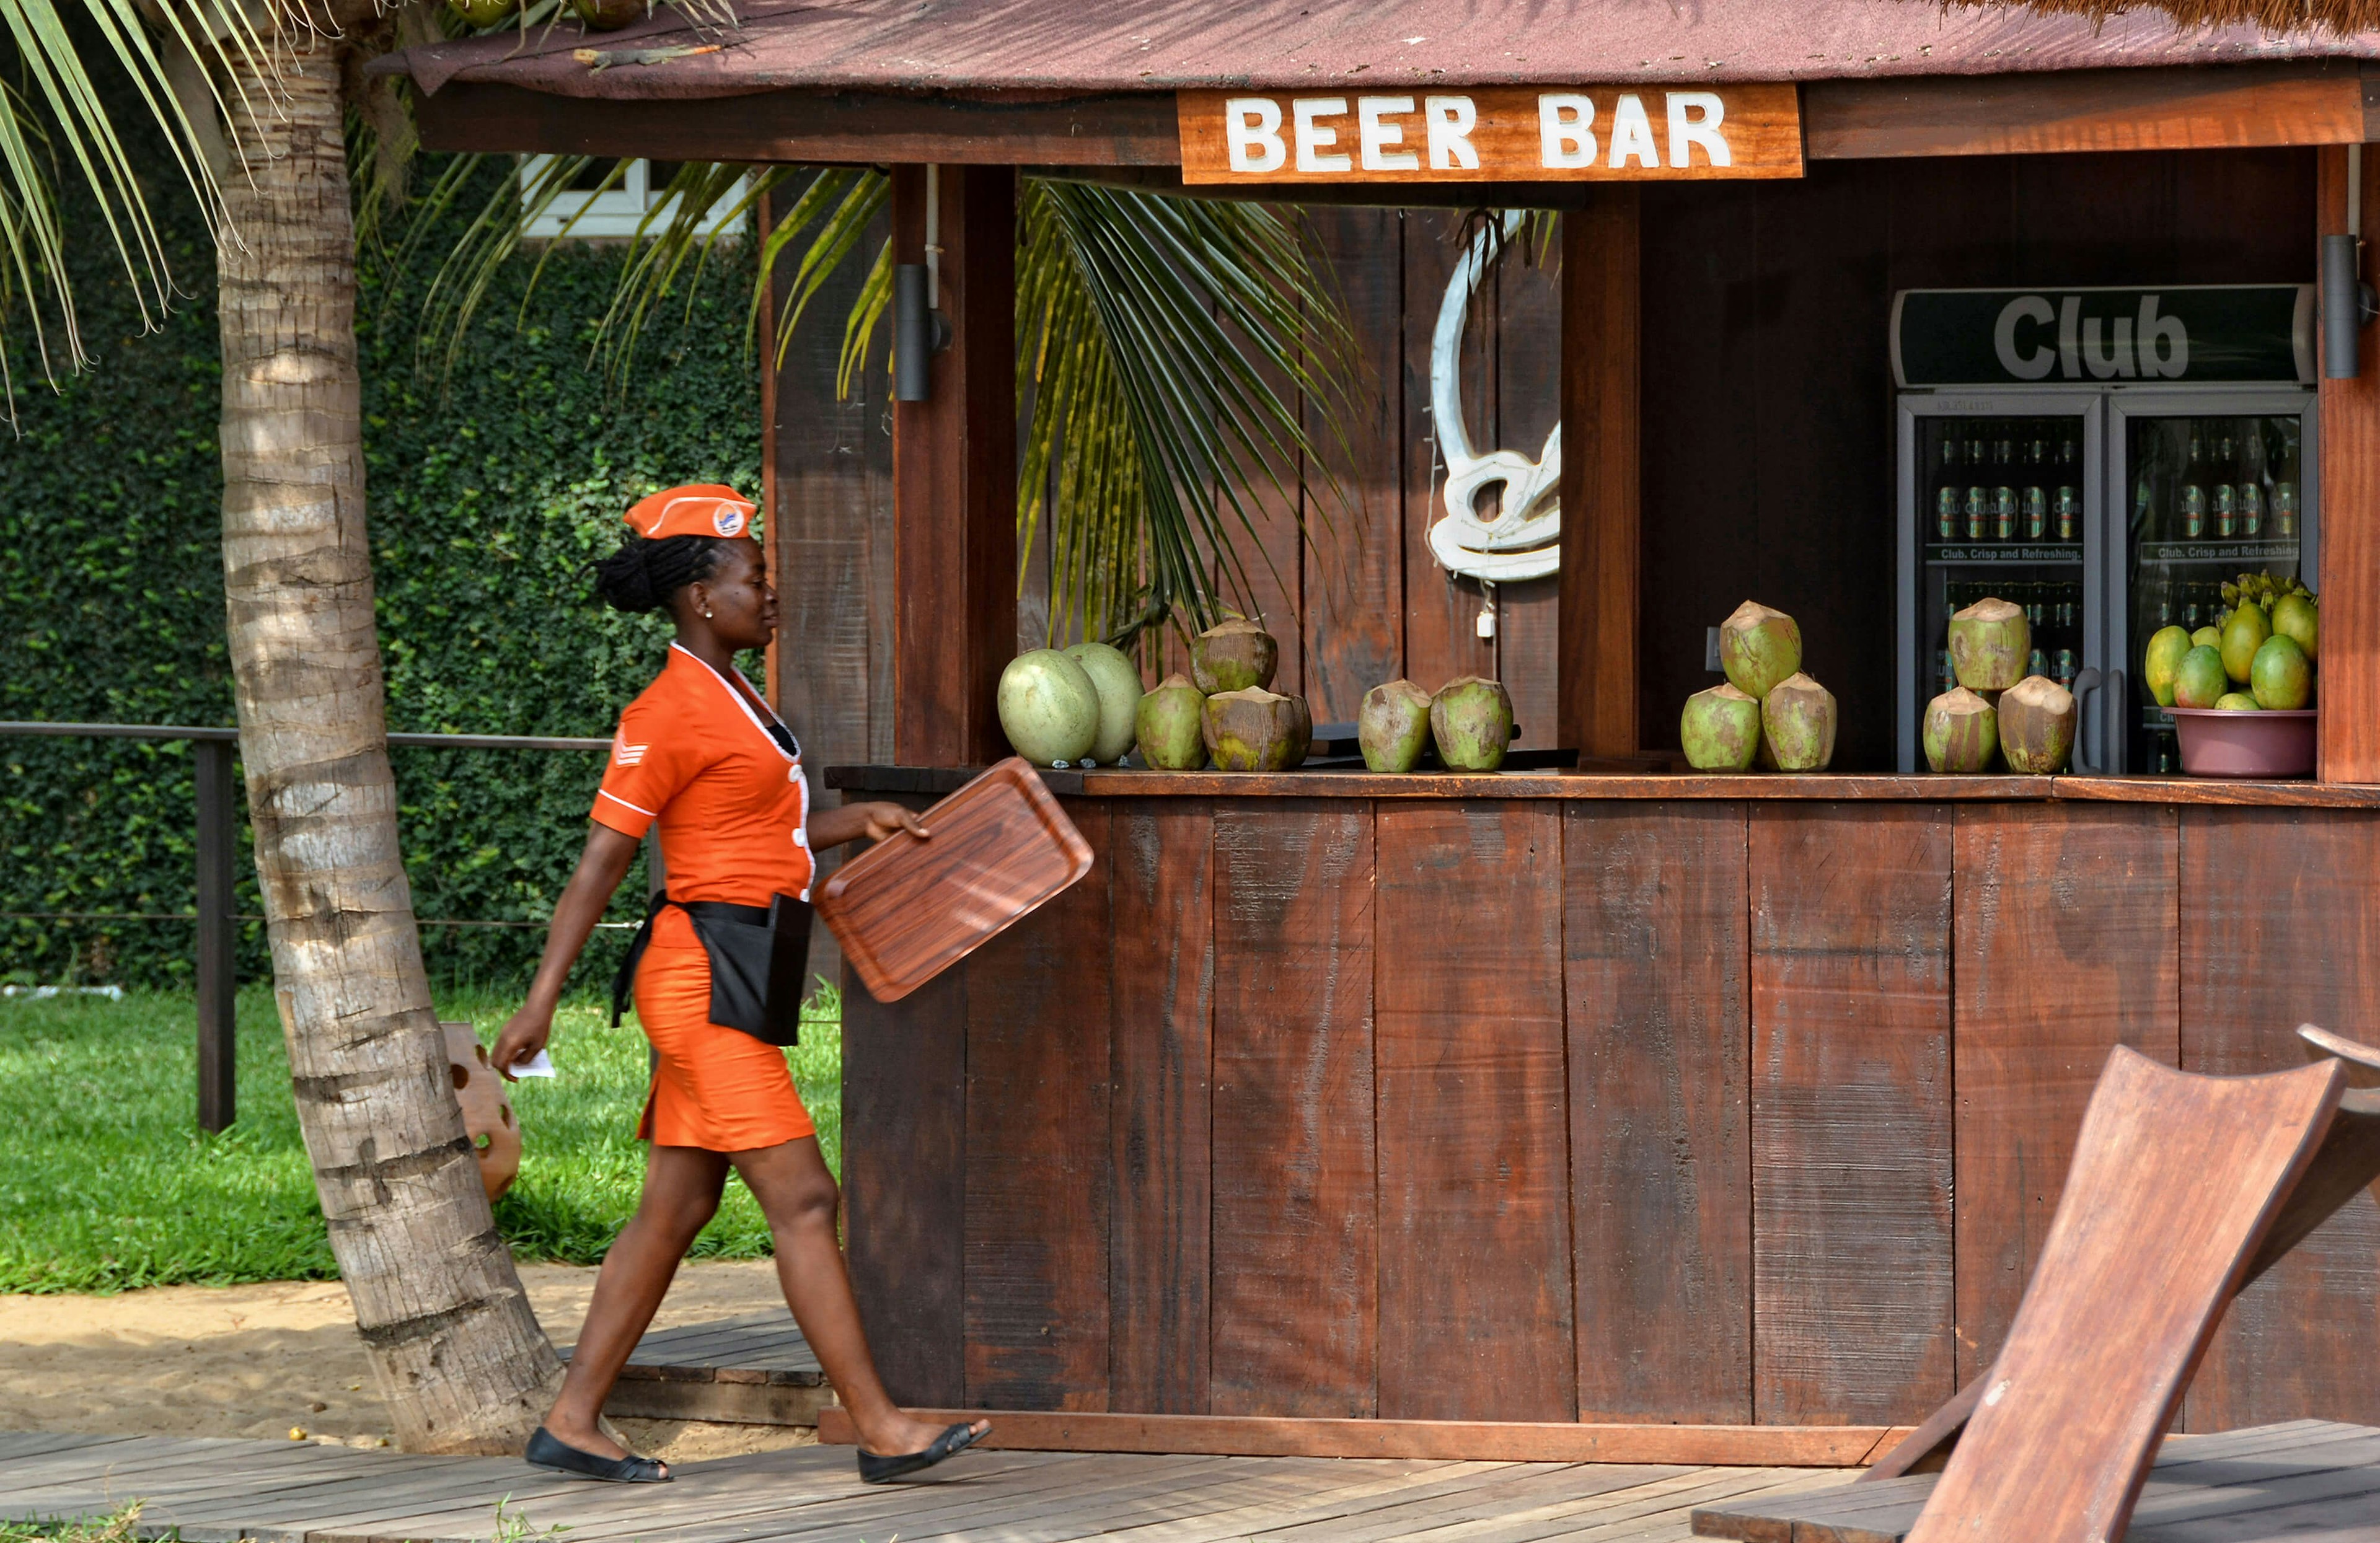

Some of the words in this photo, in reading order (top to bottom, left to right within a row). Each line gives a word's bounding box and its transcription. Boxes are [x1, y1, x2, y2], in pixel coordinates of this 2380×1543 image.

[1225, 94, 1479, 173] BEER
[1538, 91, 1731, 170] BAR
[1993, 294, 2189, 380] Club
[1941, 548, 1967, 558] Club.
[1970, 548, 1998, 561] Crisp
[2000, 548, 2019, 558] and
[2022, 548, 2081, 561] Refreshing.
[2158, 547, 2185, 558] Club.
[2188, 547, 2216, 558] Crisp
[2218, 547, 2238, 557] and
